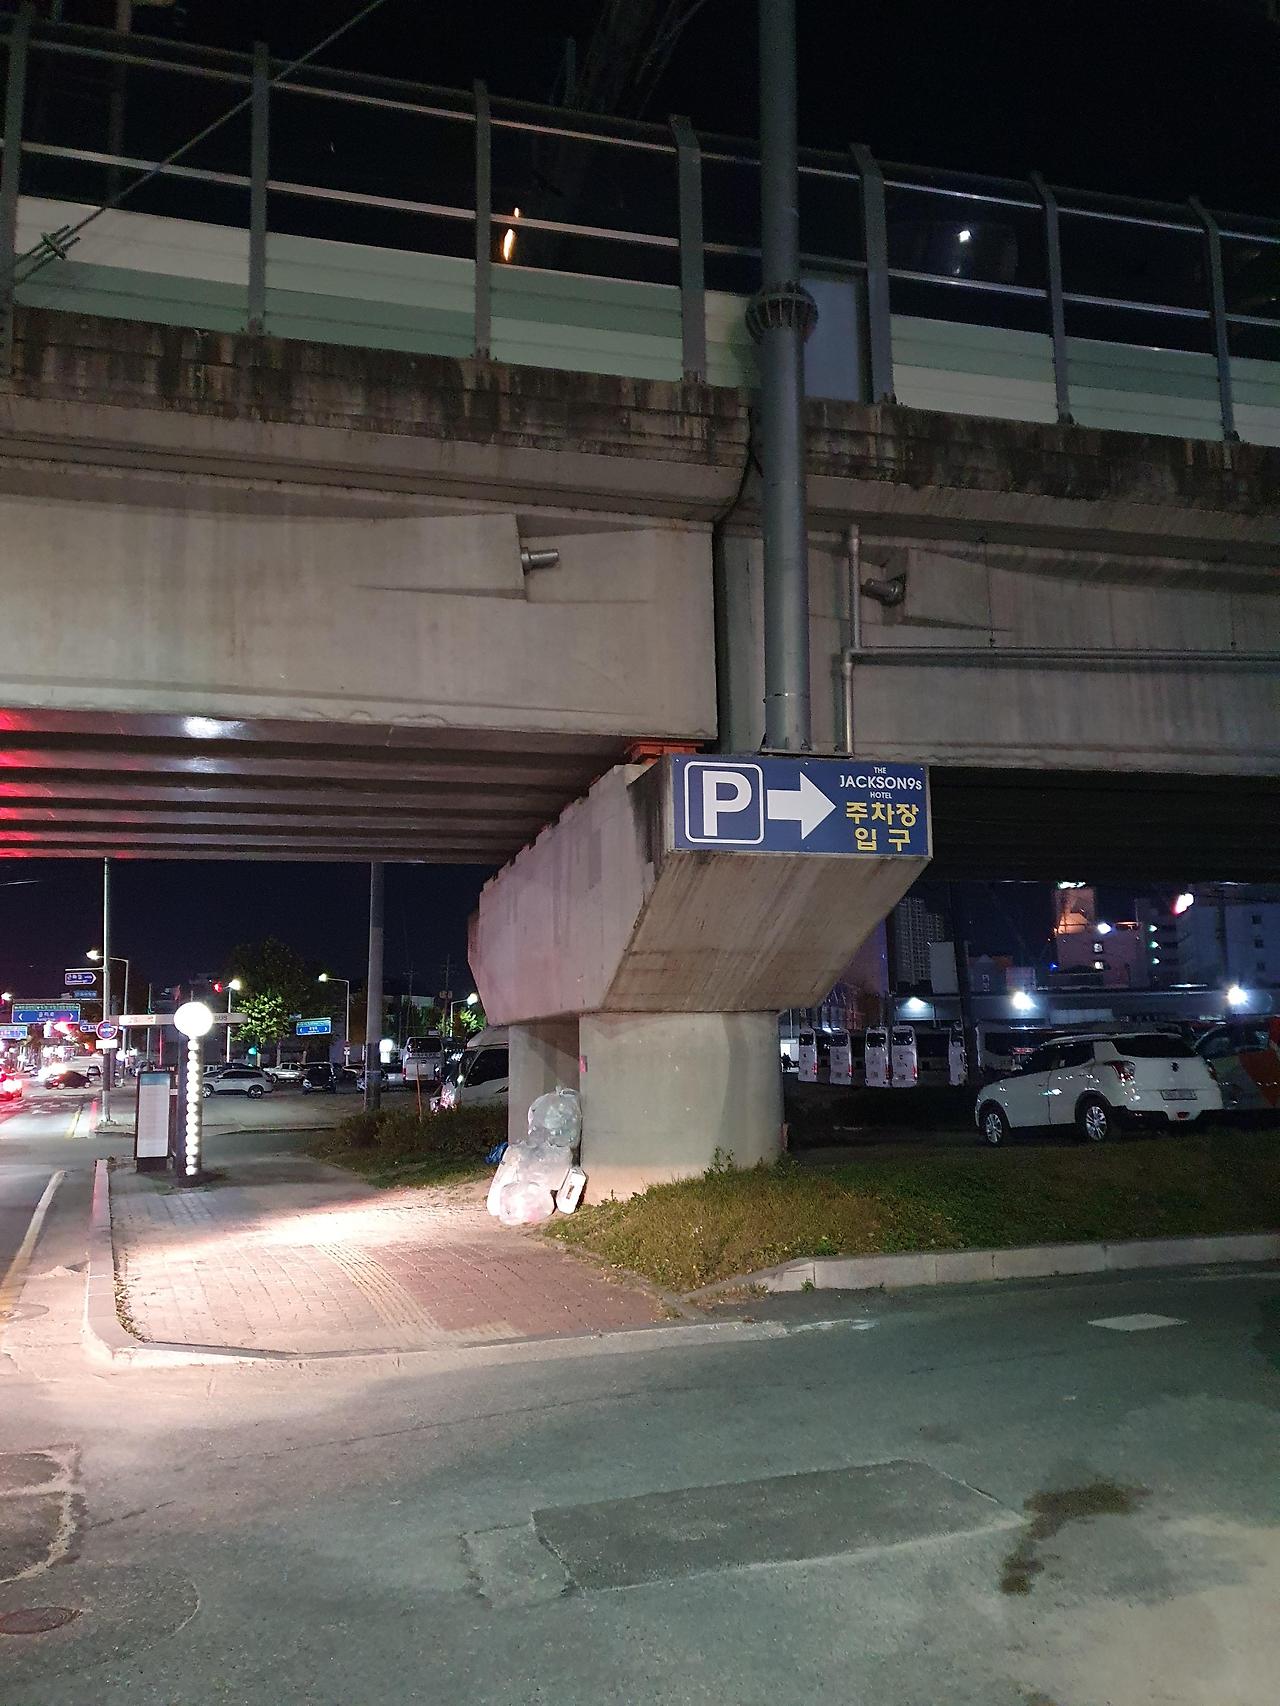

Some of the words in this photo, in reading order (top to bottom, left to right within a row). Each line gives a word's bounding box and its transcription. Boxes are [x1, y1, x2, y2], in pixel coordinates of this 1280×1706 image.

[873, 766, 887, 774] THE
[870, 791, 892, 799] HOTEL
[703, 770, 752, 837] P
[846, 802, 919, 827] 주차장
